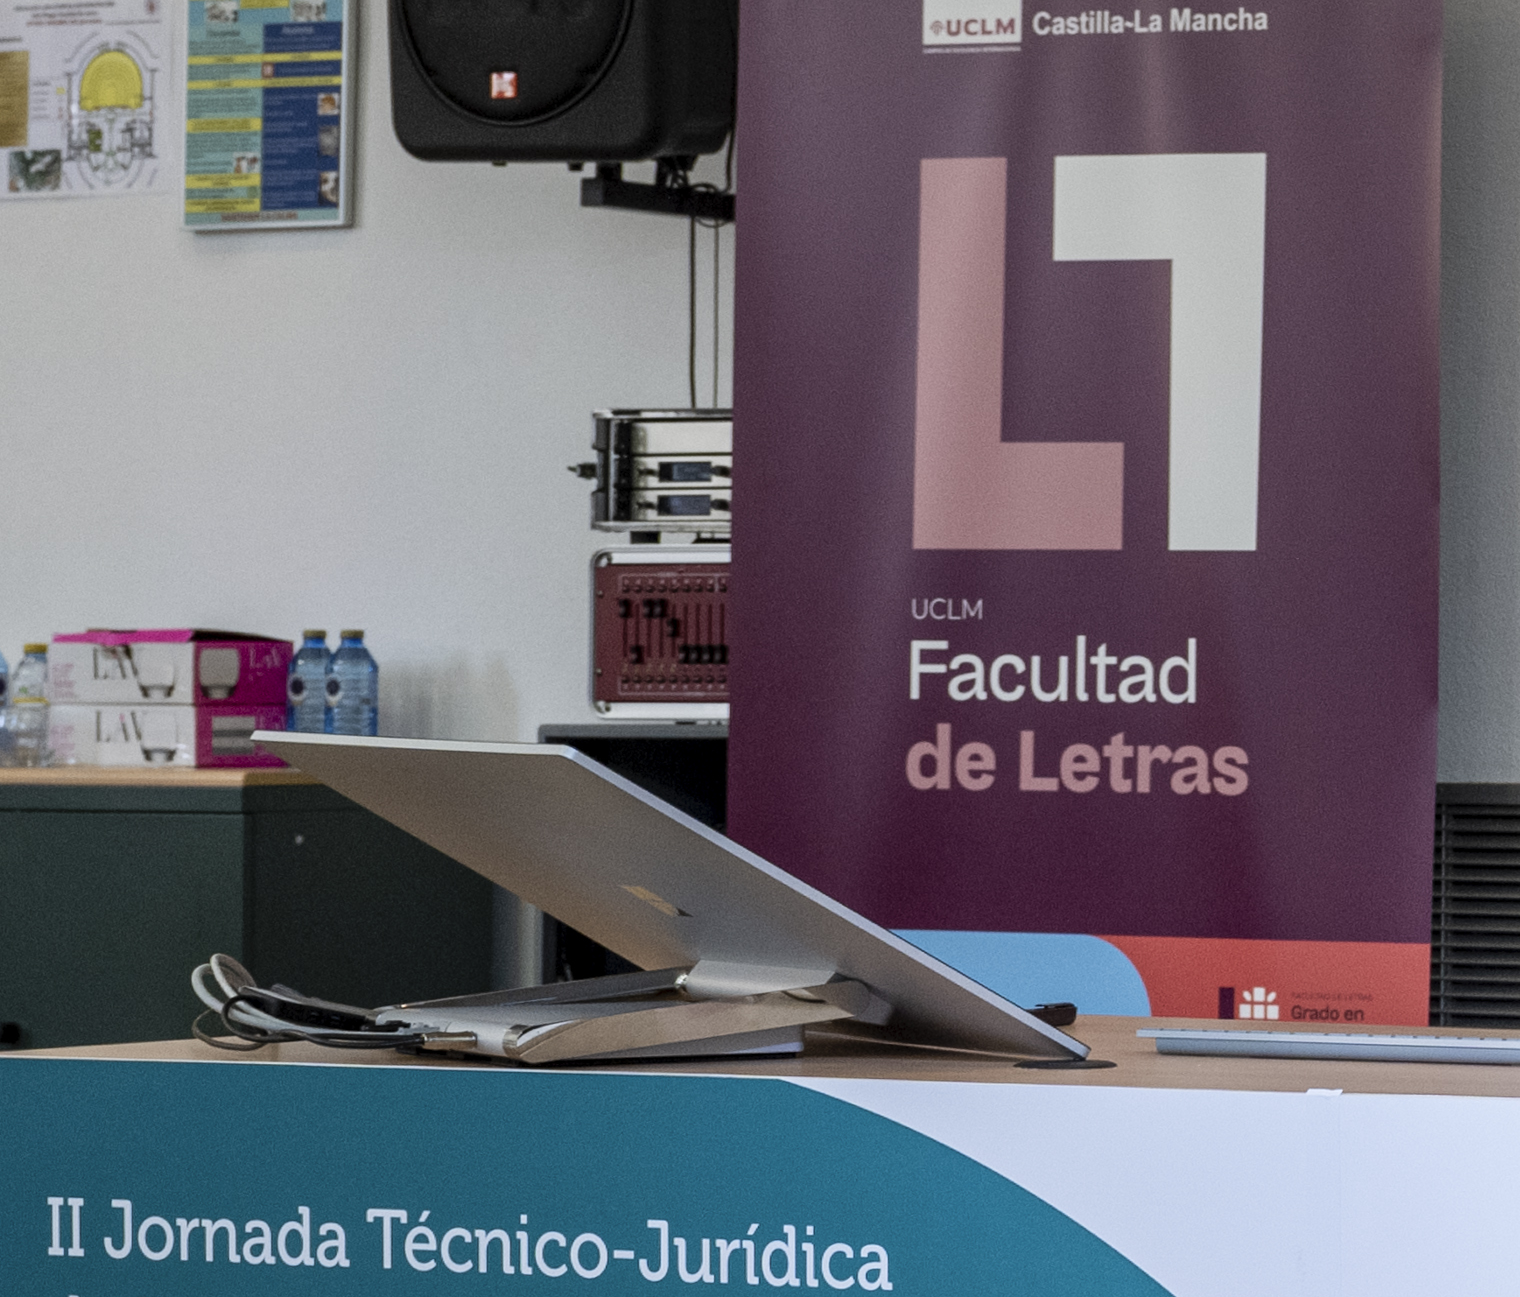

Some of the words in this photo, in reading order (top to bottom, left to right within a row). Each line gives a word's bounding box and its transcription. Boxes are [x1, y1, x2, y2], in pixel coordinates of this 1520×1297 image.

[946, 18, 1015, 36] UCLM
[1032, 10, 1162, 35] Castilla-La
[1170, 7, 1268, 32] Mancha
[912, 598, 982, 619] UCLM
[910, 635, 1196, 704] Facultad
[907, 724, 995, 790] de
[1020, 731, 1248, 795] Letras
[1291, 1005, 1340, 1021] Grado
[1344, 1008, 1365, 1021] en
[47, 1197, 84, 1256] II
[104, 1199, 350, 1267] Jornada
[366, 1209, 893, 1290] Técnico-Jurídica
